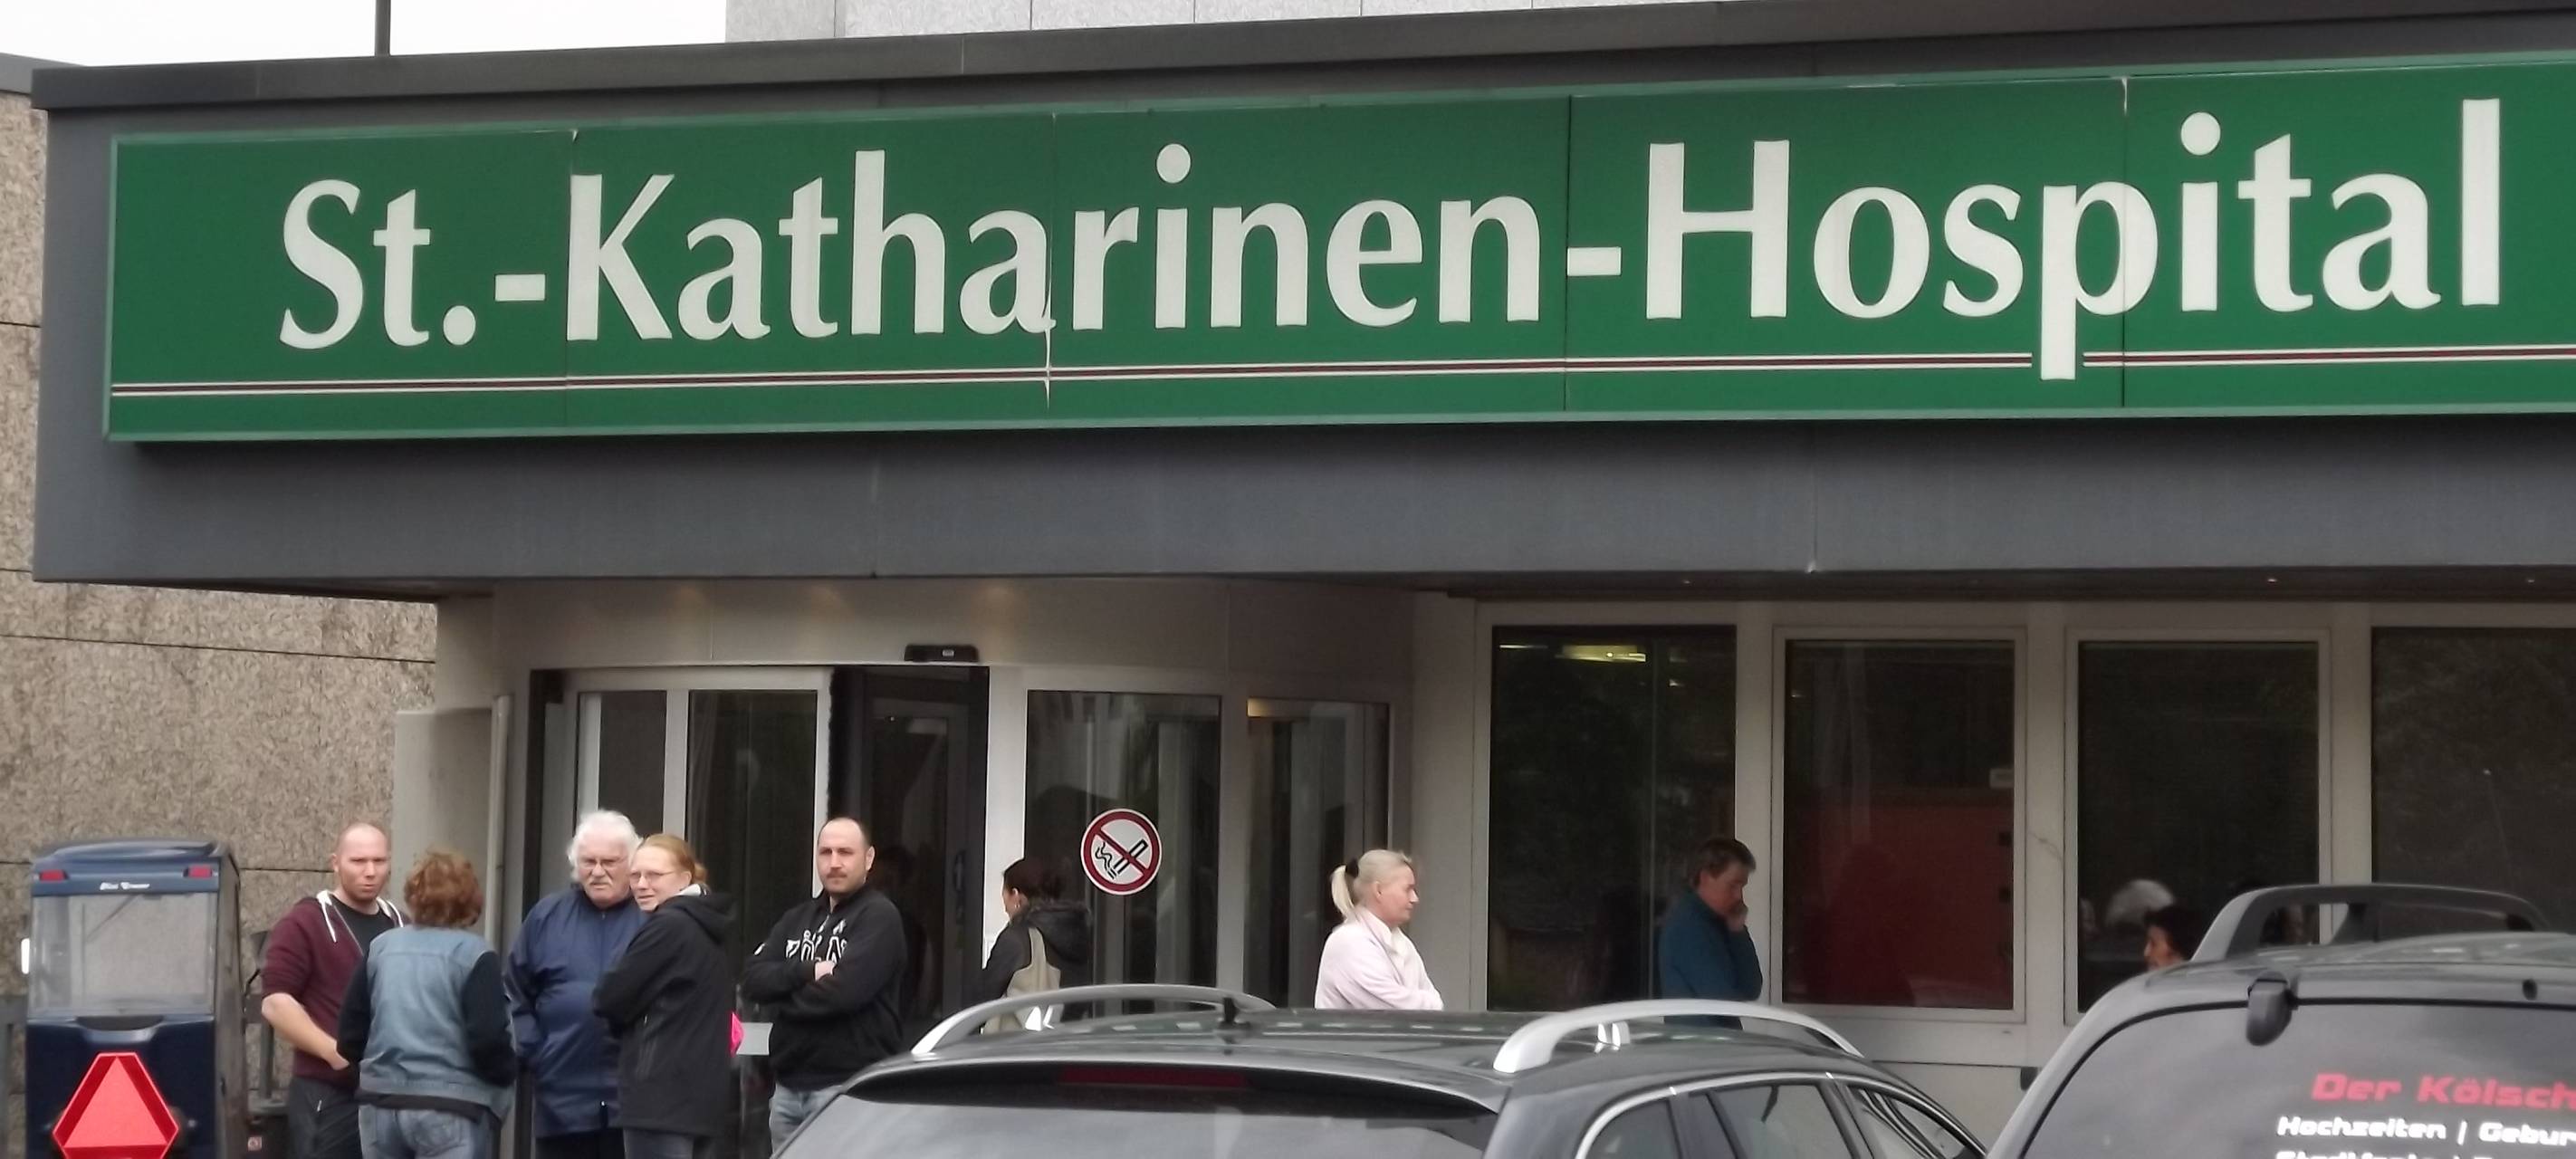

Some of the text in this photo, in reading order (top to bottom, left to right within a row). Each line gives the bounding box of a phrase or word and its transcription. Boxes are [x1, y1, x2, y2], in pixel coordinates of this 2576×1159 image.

[279, 98, 2501, 381] St.-Katharinen-Hospital
[2311, 1072, 2576, 1110] Der Kölsch
[2276, 1116, 2447, 1139] Hochzeiten
